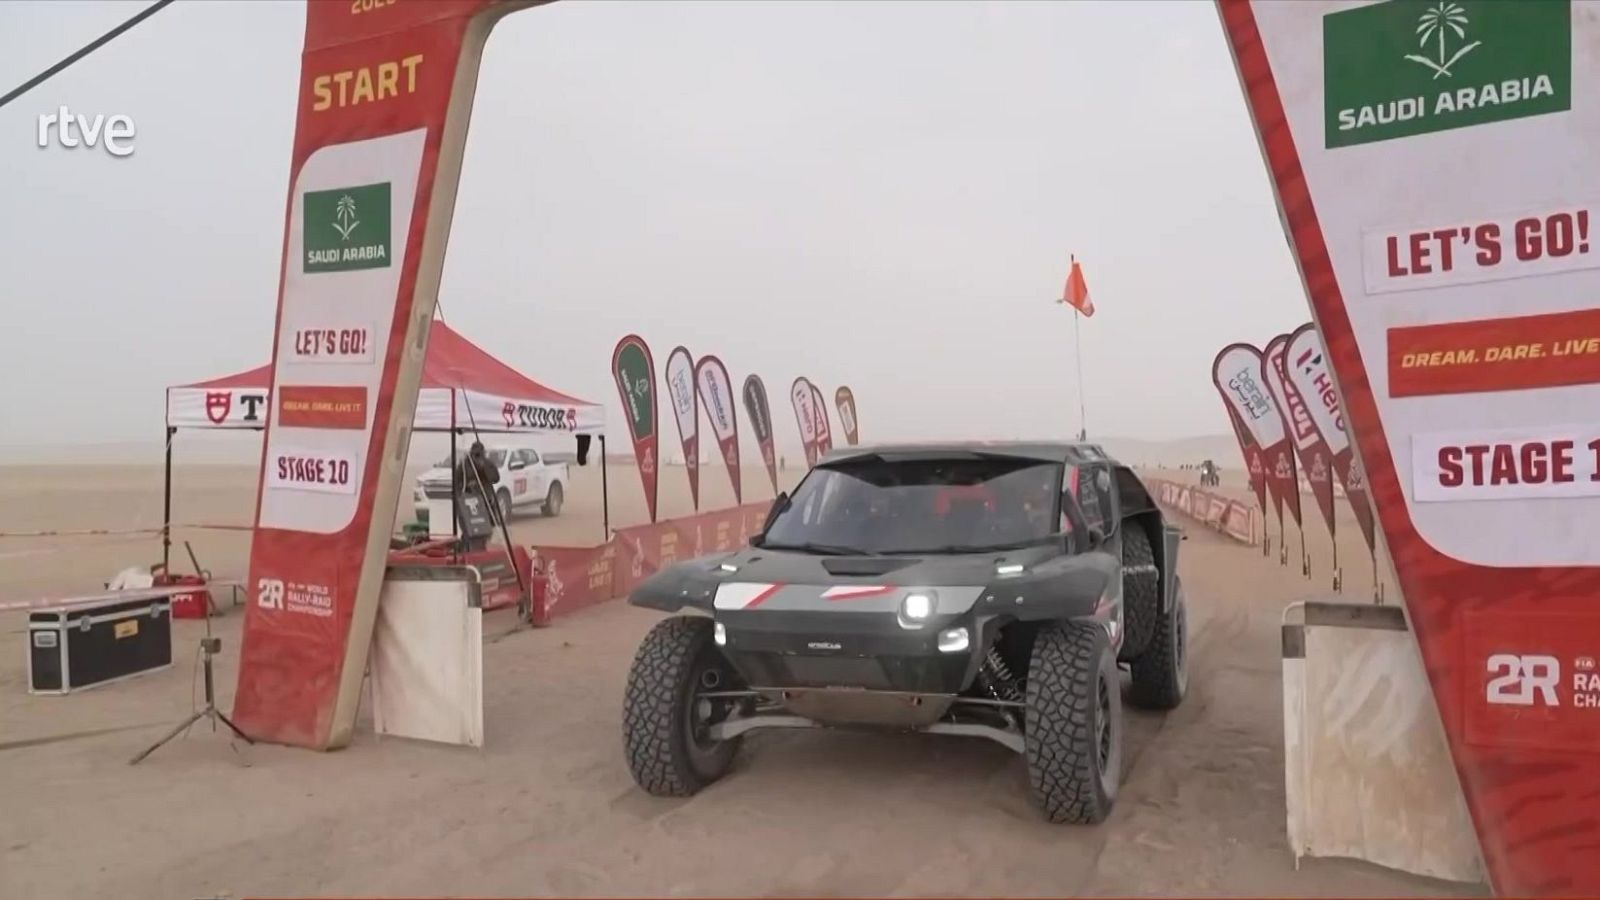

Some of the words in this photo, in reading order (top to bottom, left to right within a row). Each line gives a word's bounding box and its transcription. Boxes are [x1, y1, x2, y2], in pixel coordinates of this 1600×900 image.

[351, 0, 396, 14] 20
[313, 54, 423, 111] START
[1339, 96, 1424, 131] SAUDI
[1434, 75, 1554, 115] ARABIA
[308, 249, 340, 264] SAUDI
[343, 245, 386, 262] ARABIA
[1387, 223, 1502, 277] LET'S
[1515, 210, 1589, 262] GO!
[296, 330, 336, 355] LET'S
[340, 329, 366, 355] GO!
[1402, 350, 1479, 369] DREAM.
[1485, 343, 1546, 362] DARE.
[1552, 338, 1600, 356] LIVE
[240, 395, 264, 420] T
[518, 405, 567, 429] TUDOR
[278, 456, 325, 483] STAGE
[328, 459, 349, 485] 10
[1438, 440, 1575, 487] STAGE
[1574, 693, 1600, 707] CH
